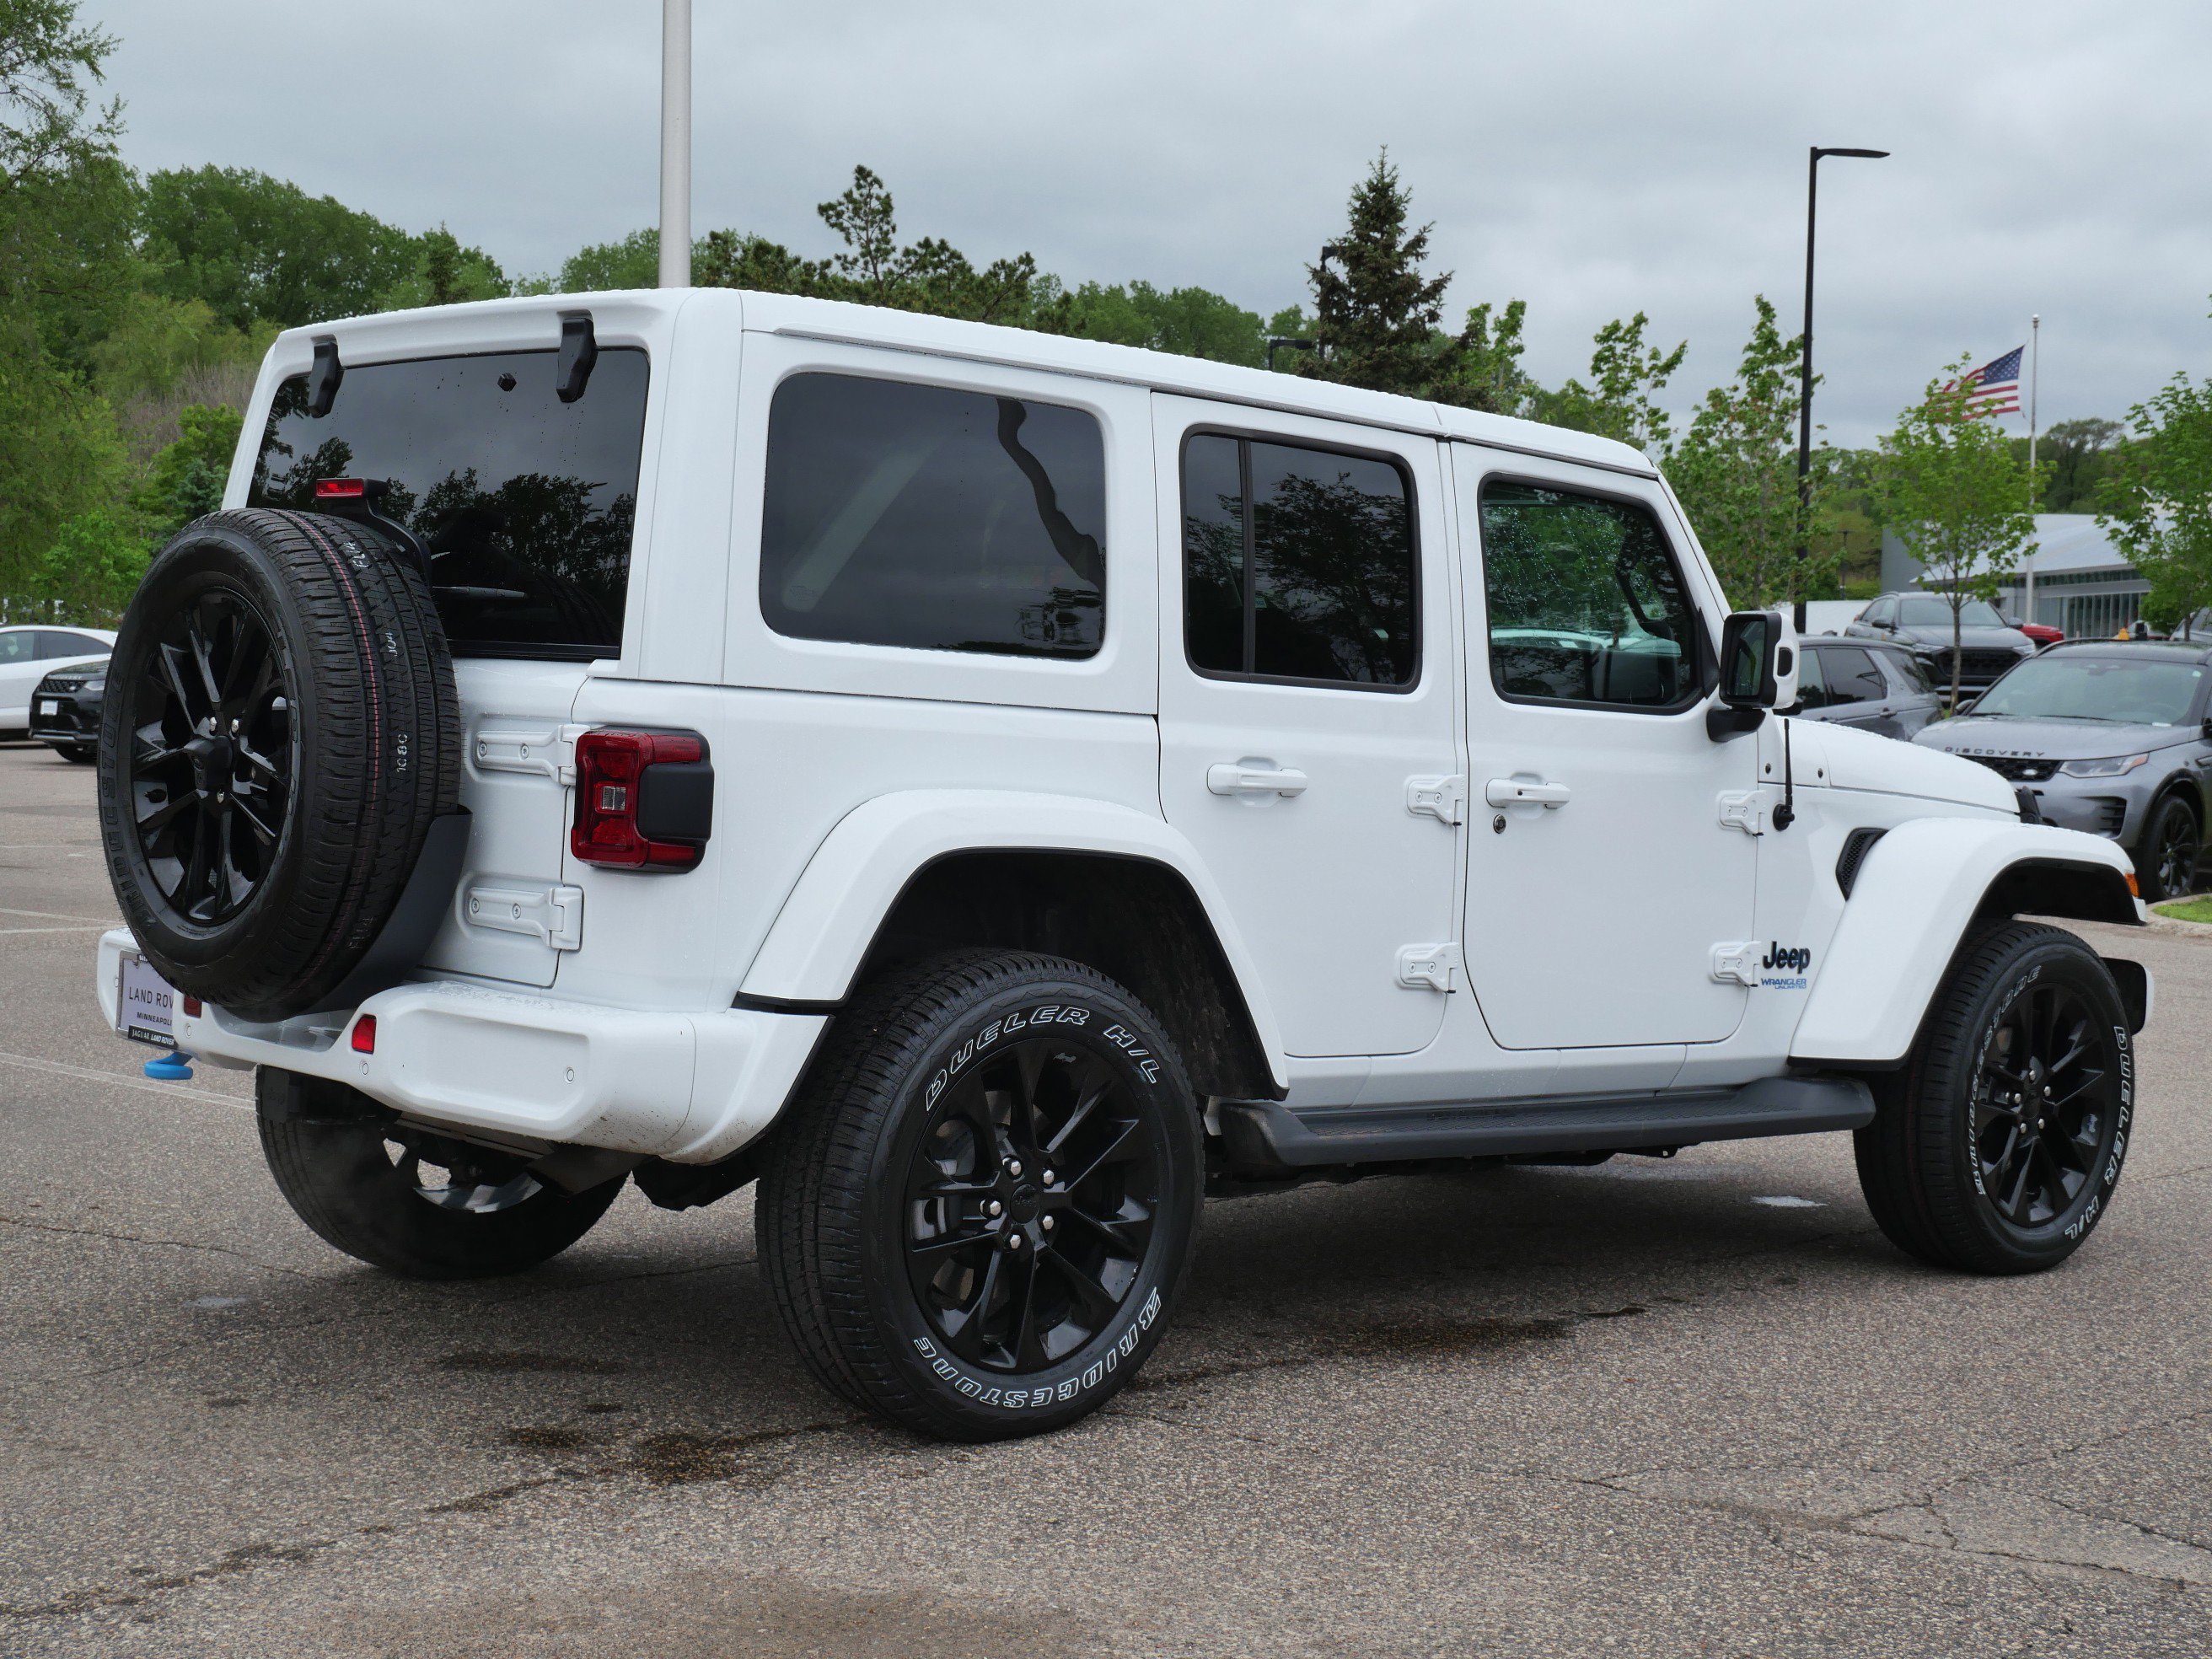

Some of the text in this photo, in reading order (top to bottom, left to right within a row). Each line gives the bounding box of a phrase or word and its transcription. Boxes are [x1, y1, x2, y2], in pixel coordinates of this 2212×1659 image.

[1944, 746, 2046, 757] DISCOVERY
[1763, 941, 1811, 974] Jeep
[129, 986, 174, 1010] LAND ROV
[132, 1029, 150, 1039] JAGUAR
[137, 1012, 172, 1026] MINNEAPOLI
[926, 1006, 1090, 1111] DUELER
[1968, 965, 2042, 1196] BRIDGESTONE
[2104, 1025, 2131, 1185] DUELER
[913, 1286, 1162, 1408] BRIDGESTONE
